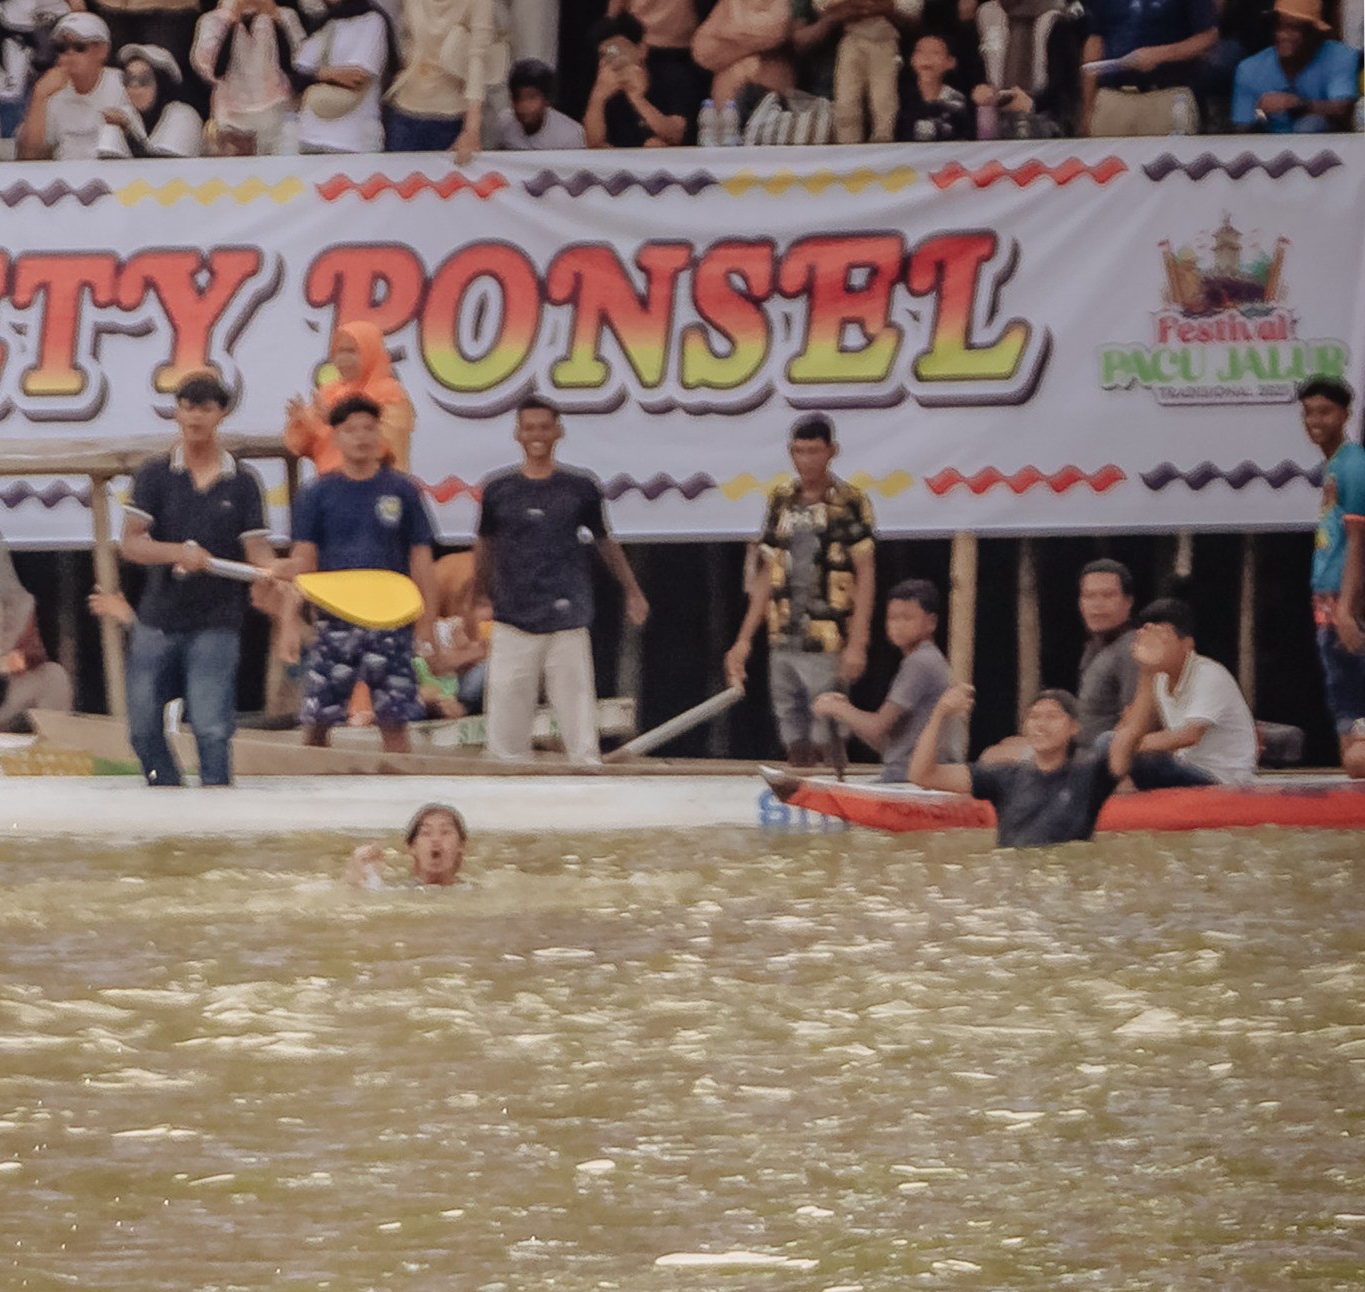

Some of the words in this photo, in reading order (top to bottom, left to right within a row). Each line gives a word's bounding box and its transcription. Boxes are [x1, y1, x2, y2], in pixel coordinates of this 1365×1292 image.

[304, 229, 1033, 395] PONSEL
[1158, 313, 1288, 343] Festival
[1101, 347, 1206, 383] PACU
[1216, 345, 1346, 382] JALUR
